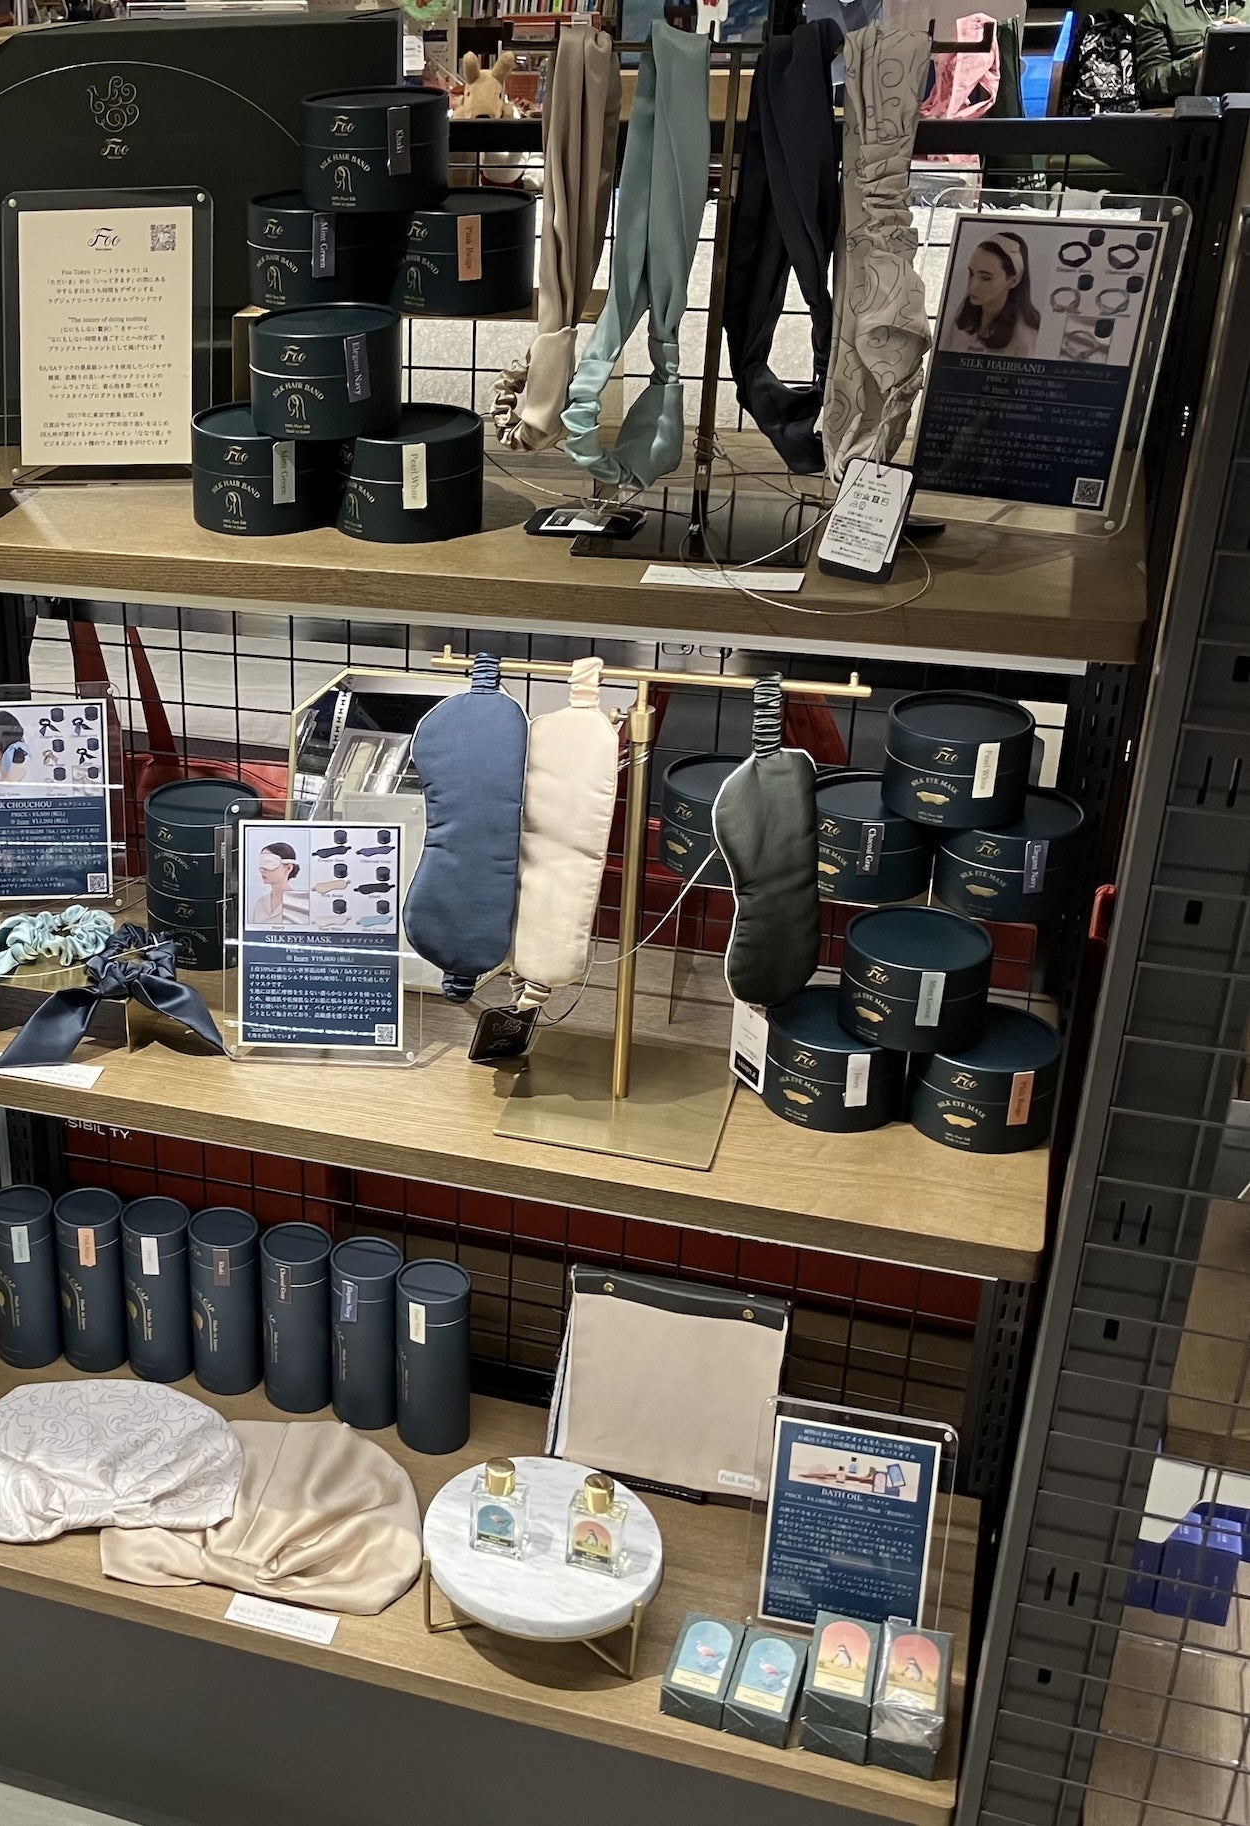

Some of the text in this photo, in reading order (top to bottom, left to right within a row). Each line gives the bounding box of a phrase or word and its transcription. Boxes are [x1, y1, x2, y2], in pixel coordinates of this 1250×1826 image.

[330, 115, 356, 133] Foo
[101, 138, 129, 156] Foo
[396, 129, 405, 154] Khaki
[332, 153, 350, 161] HAIR
[351, 154, 371, 172] BAND
[87, 227, 121, 247] Foo
[280, 256, 298, 274] BAND
[318, 243, 328, 269] Green
[421, 257, 440, 275] BAND
[280, 345, 307, 363] Foo
[960, 358, 1046, 374] SILK HAIRBAND
[272, 382, 324, 400] SILK HAIR BAND
[353, 373, 363, 395] Navy
[223, 445, 249, 462] Foo
[410, 453, 418, 500] Pearl White
[224, 479, 240, 488] HAIR
[241, 481, 261, 499] BAND
[358, 483, 375, 504] BAND
[932, 747, 959, 763] Foo
[984, 750, 993, 769] Pearl
[925, 777, 939, 785] EYE
[6, 801, 52, 809] CHOUCHOU
[974, 870, 988, 878] EYE
[1028, 870, 1037, 889] Navy
[265, 935, 284, 943] SILK
[875, 998, 893, 1015] MASK
[793, 1050, 818, 1068] Foo
[790, 1076, 822, 1097] EYE MASK
[951, 1071, 978, 1089] Foo
[937, 1100, 986, 1119] SILK EYE MASK
[3, 1273, 16, 1288] CAP
[69, 1278, 82, 1292] CAP
[136, 1287, 149, 1301] CAP
[203, 1298, 215, 1312] CAP
[821, 1487, 845, 1498] BATH
[847, 1493, 863, 1502] OIL
